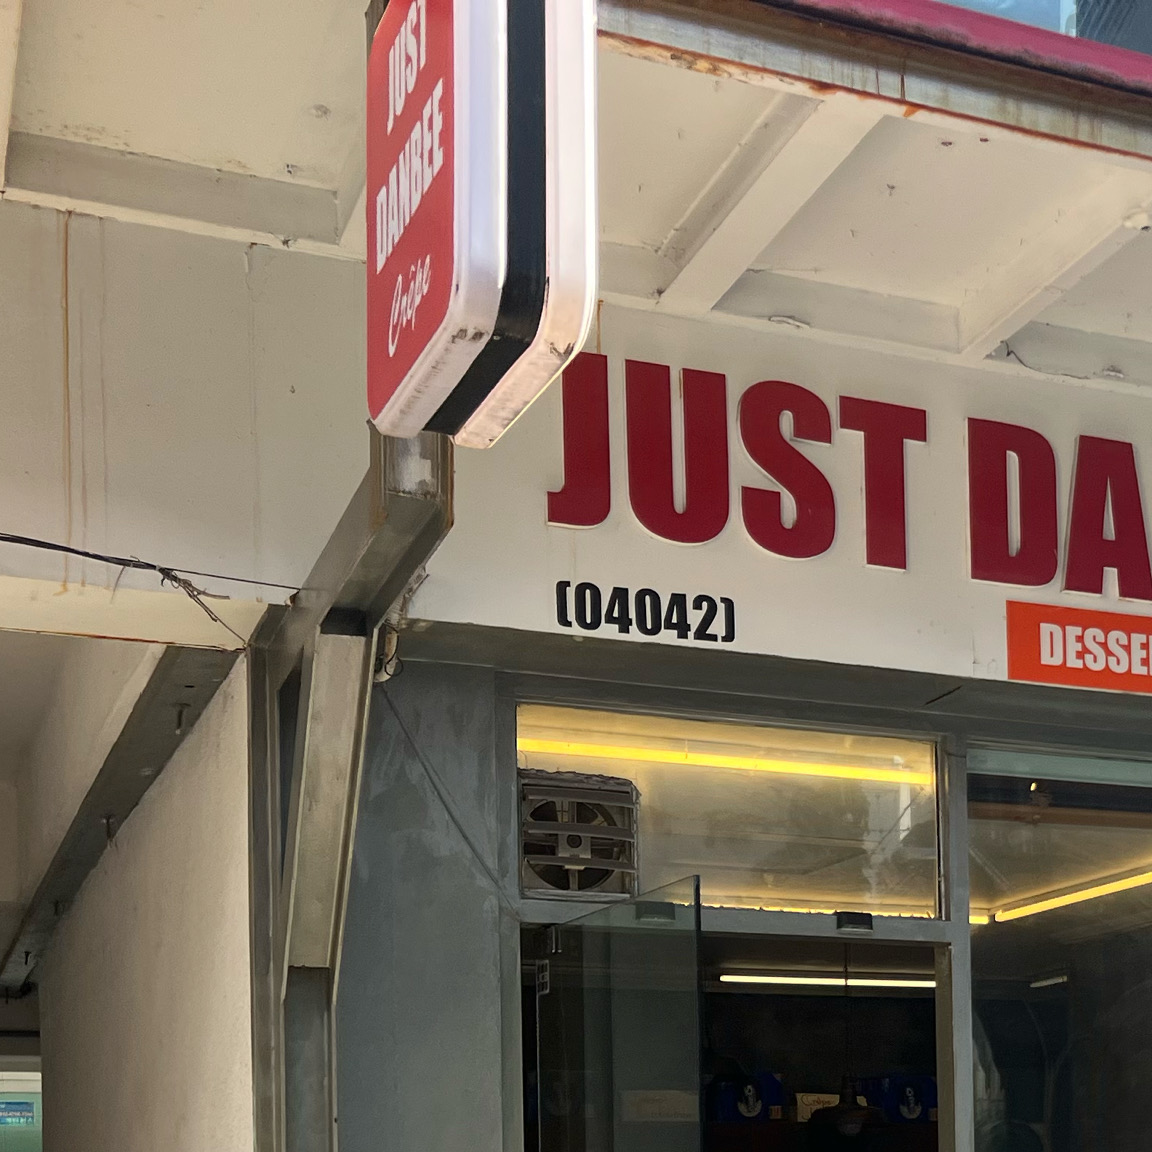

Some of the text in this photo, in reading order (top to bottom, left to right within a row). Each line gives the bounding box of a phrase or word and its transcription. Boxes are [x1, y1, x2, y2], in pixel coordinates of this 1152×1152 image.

[387, 0, 427, 135] JUST
[376, 78, 444, 274] DANBEE
[547, 352, 928, 572] JUST
